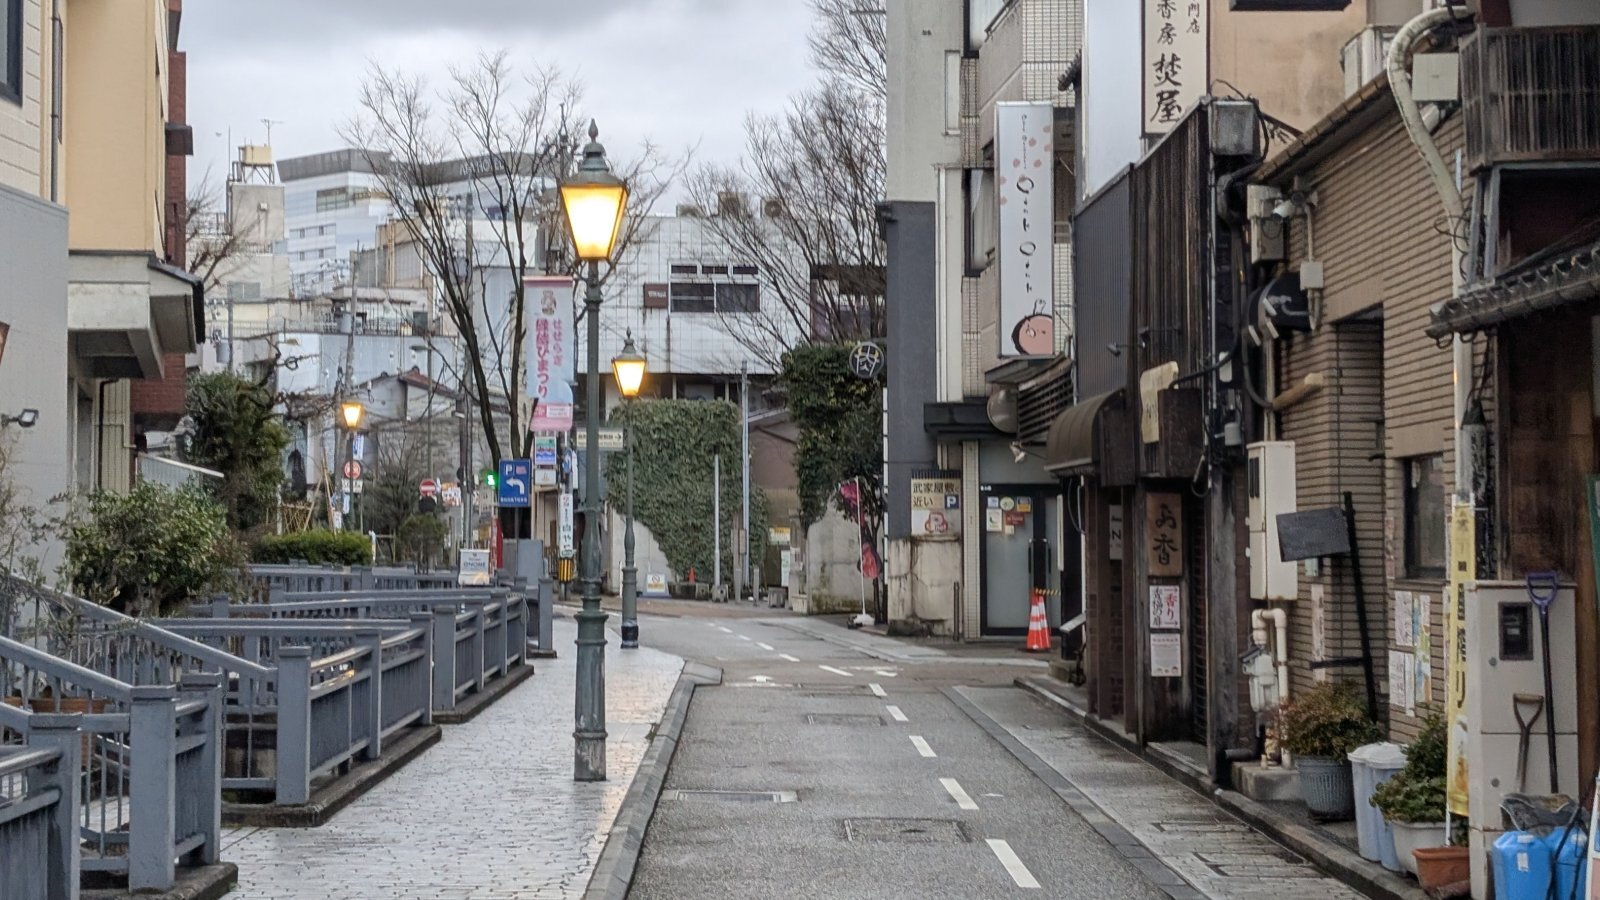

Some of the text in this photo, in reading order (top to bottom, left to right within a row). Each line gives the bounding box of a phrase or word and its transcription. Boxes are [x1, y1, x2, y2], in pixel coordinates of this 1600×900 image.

[505, 464, 513, 476] P
[912, 495, 957, 508] 近い P
